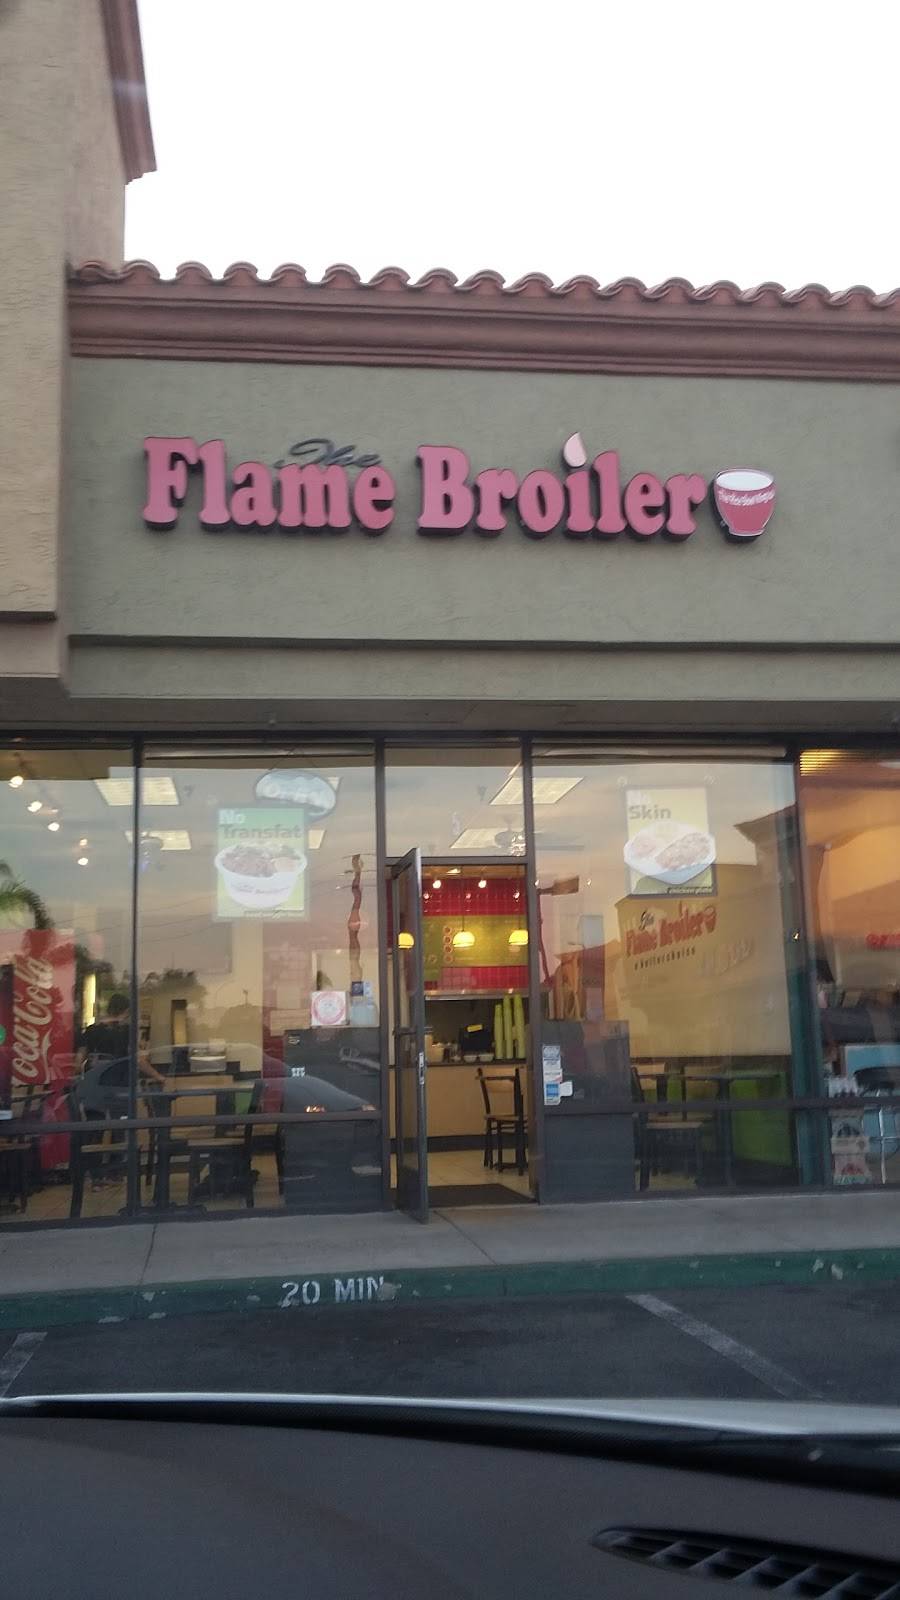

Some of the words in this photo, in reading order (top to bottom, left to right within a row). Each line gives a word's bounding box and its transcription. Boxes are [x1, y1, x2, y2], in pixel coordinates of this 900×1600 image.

[274, 438, 382, 469] The
[143, 437, 396, 532] Flame
[417, 432, 707, 538] Broiler
[219, 809, 246, 824] No
[628, 805, 671, 819] Skin
[219, 824, 301, 839] Transfat
[281, 1279, 320, 1307] 20
[334, 1276, 384, 1302] MIN
